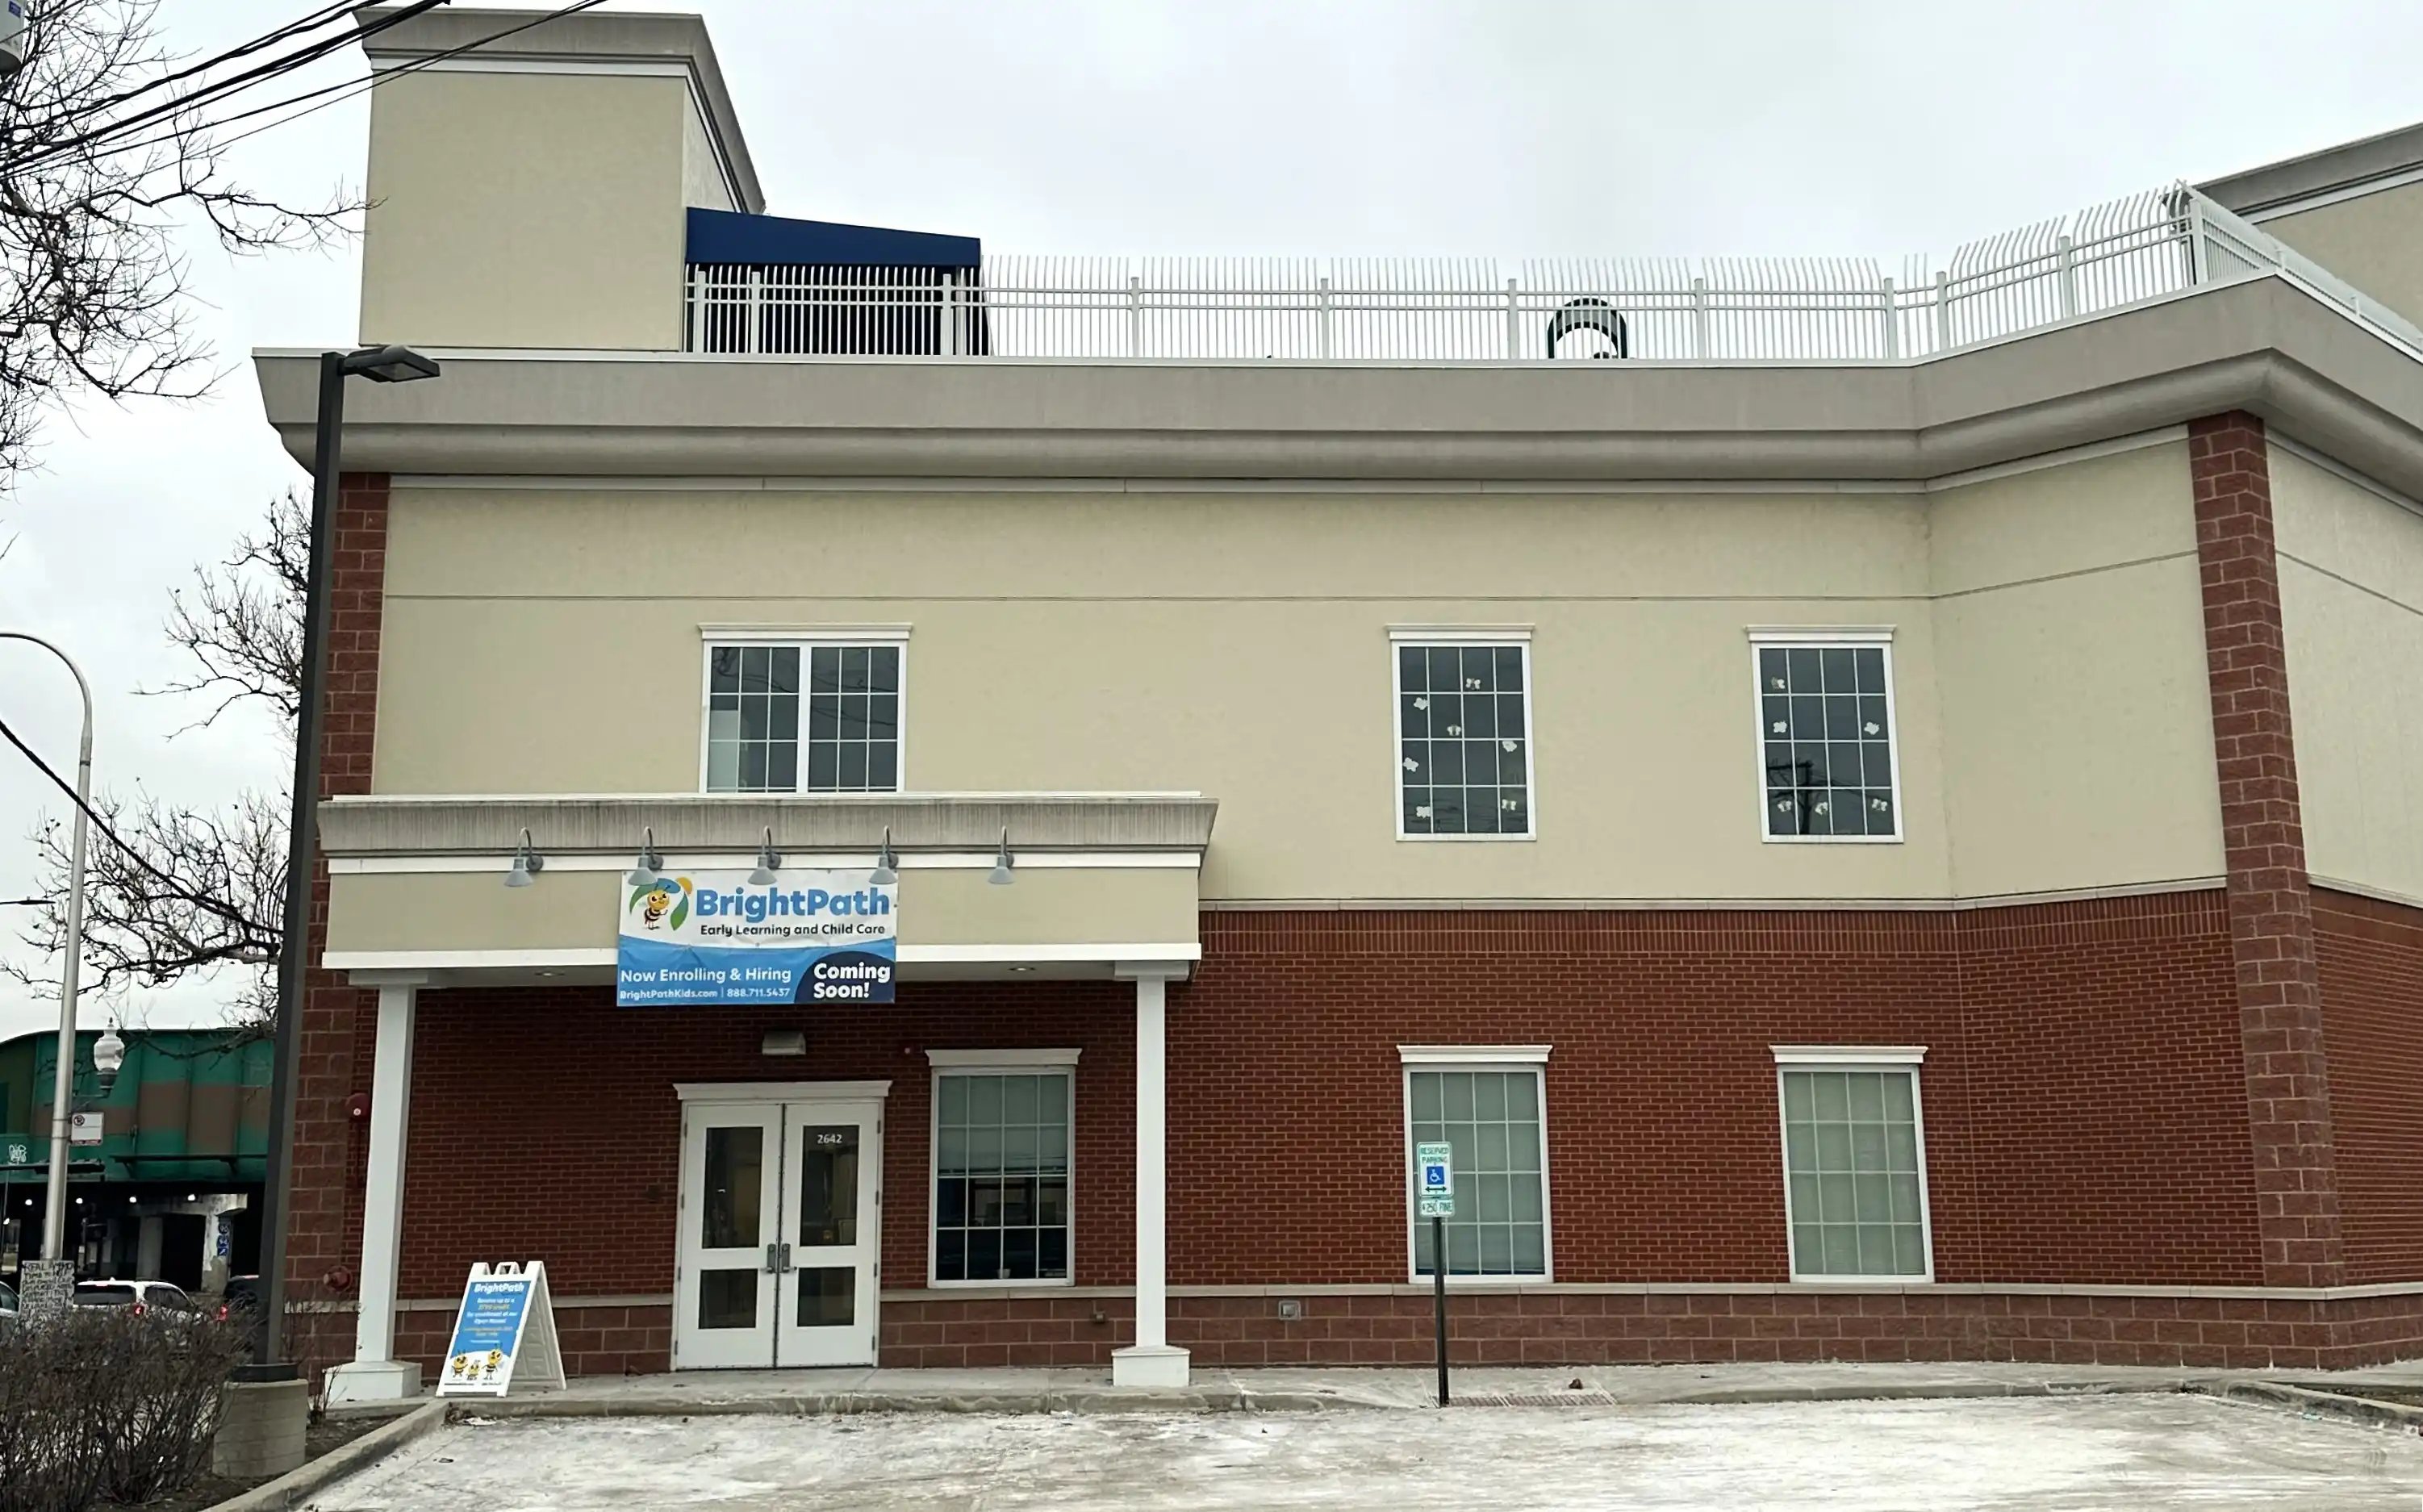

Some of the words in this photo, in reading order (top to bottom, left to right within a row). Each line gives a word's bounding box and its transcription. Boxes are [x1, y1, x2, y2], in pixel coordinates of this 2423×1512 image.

[696, 887, 890, 923] BrightPath
[700, 924, 733, 937] Early
[736, 924, 791, 937] Learning
[794, 924, 818, 935] and
[821, 923, 853, 935] Child
[857, 923, 885, 934] Care
[620, 970, 656, 982] Now
[660, 968, 726, 984] Enrolling
[729, 968, 742, 981] &
[746, 967, 792, 984] Hiring
[813, 961, 891, 984] Coming
[620, 988, 718, 1000] BrightPathKids.com
[727, 988, 791, 997] 888.711.5437
[813, 982, 870, 999] Soon!
[817, 1134, 842, 1144] 2642
[474, 1282, 525, 1295] BrightPath
